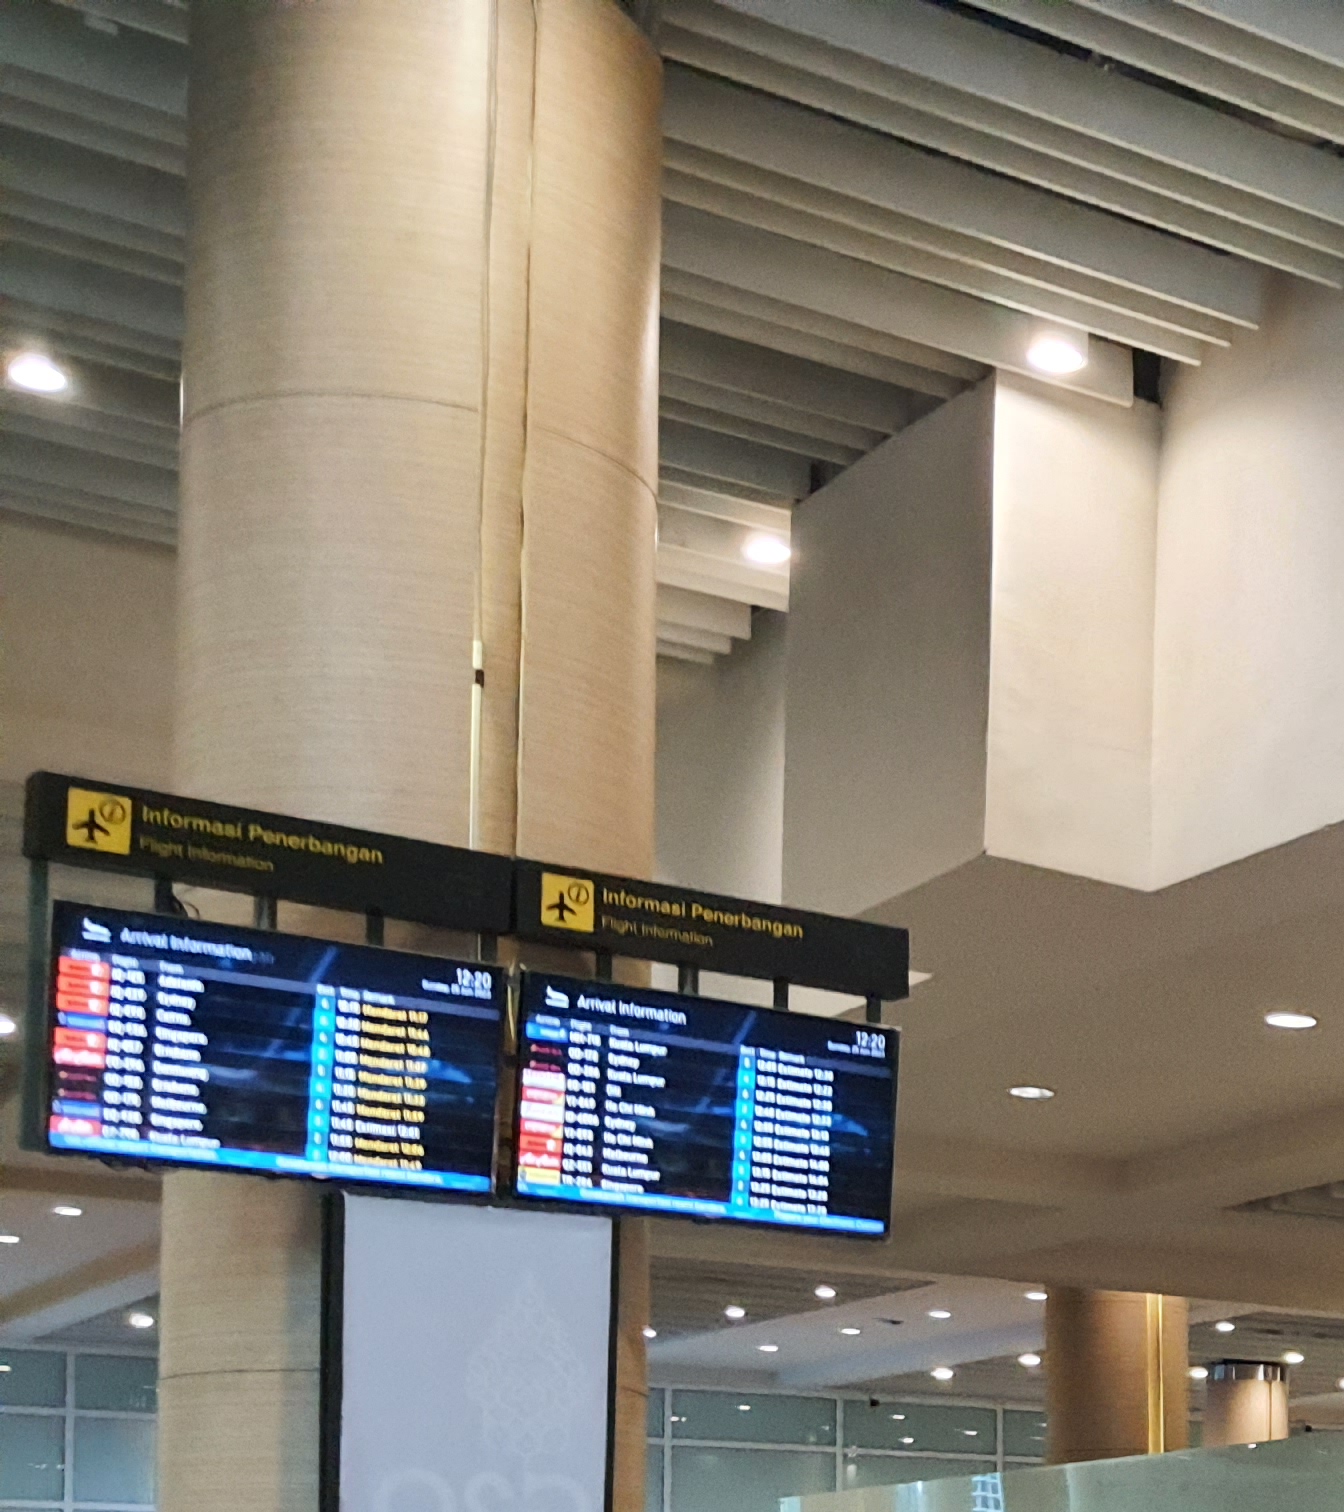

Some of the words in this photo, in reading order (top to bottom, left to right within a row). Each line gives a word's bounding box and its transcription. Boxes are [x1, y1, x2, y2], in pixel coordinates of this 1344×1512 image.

[141, 804, 242, 840] Informasi
[248, 823, 384, 866] Penerbangan
[139, 835, 183, 858] Flight
[188, 845, 274, 873] Information
[602, 888, 685, 918] Informasi
[691, 903, 803, 940] Penerbangan
[120, 927, 169, 949] Arrival
[170, 935, 252, 961] Information
[601, 915, 637, 935] Flight
[641, 923, 714, 948] Information
[577, 994, 617, 1014] Arrival
[618, 1000, 686, 1025] Information
[856, 1031, 886, 1049] 12:20
[608, 1053, 640, 1069] Sydney
[604, 1116, 636, 1132] Sydney
[602, 1148, 648, 1164] Melbourne
